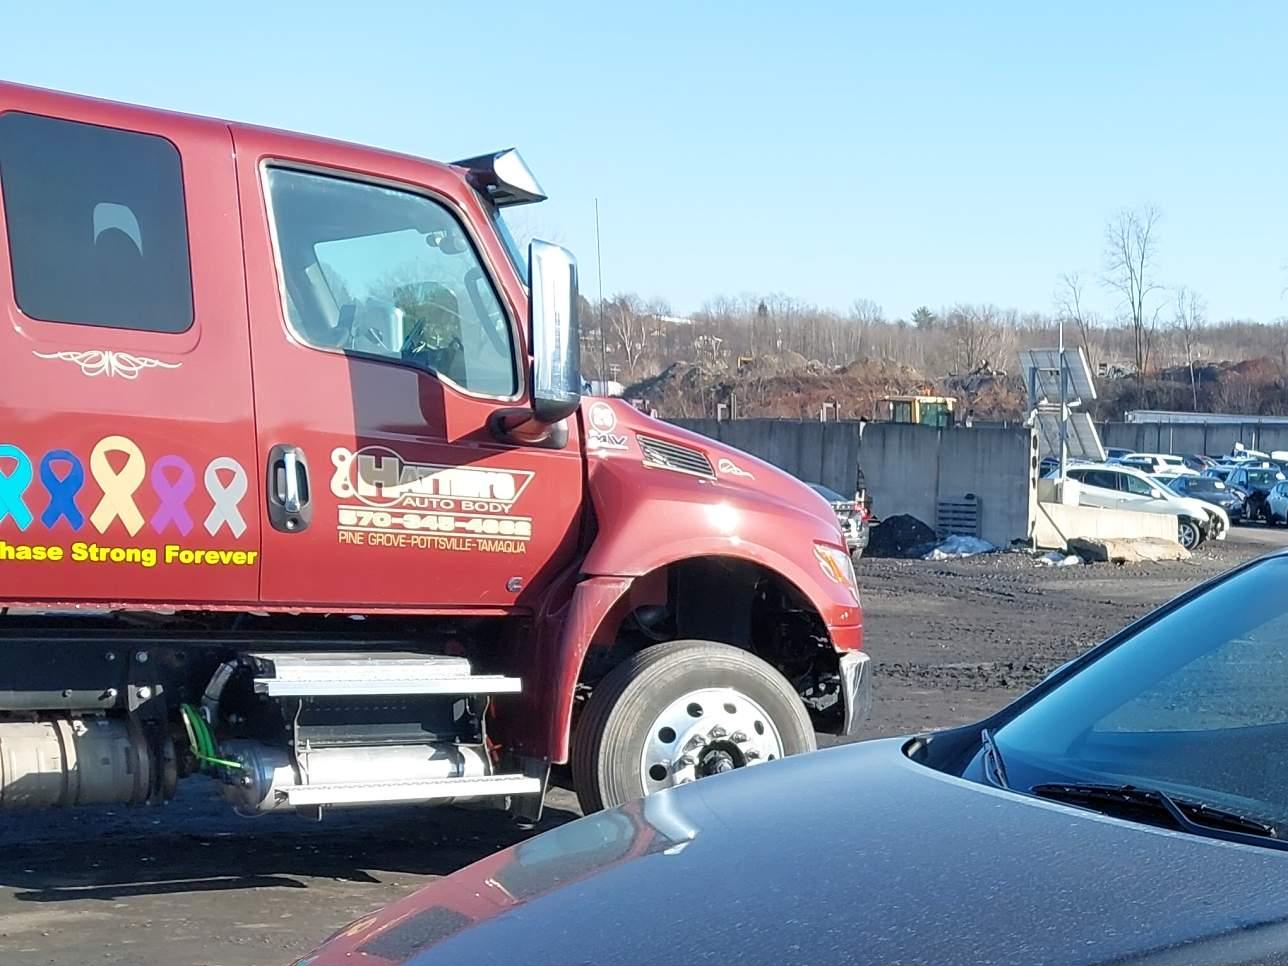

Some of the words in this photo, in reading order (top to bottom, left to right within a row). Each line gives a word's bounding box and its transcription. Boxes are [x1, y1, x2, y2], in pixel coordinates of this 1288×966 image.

[402, 497, 455, 510] AUTO
[461, 501, 513, 514] BODY
[338, 531, 364, 545] PINE
[368, 532, 527, 554] GROVE-POTTSVILLE-TAMAQUA
[71, 542, 156, 567] Strong
[164, 544, 258, 565] Forever
